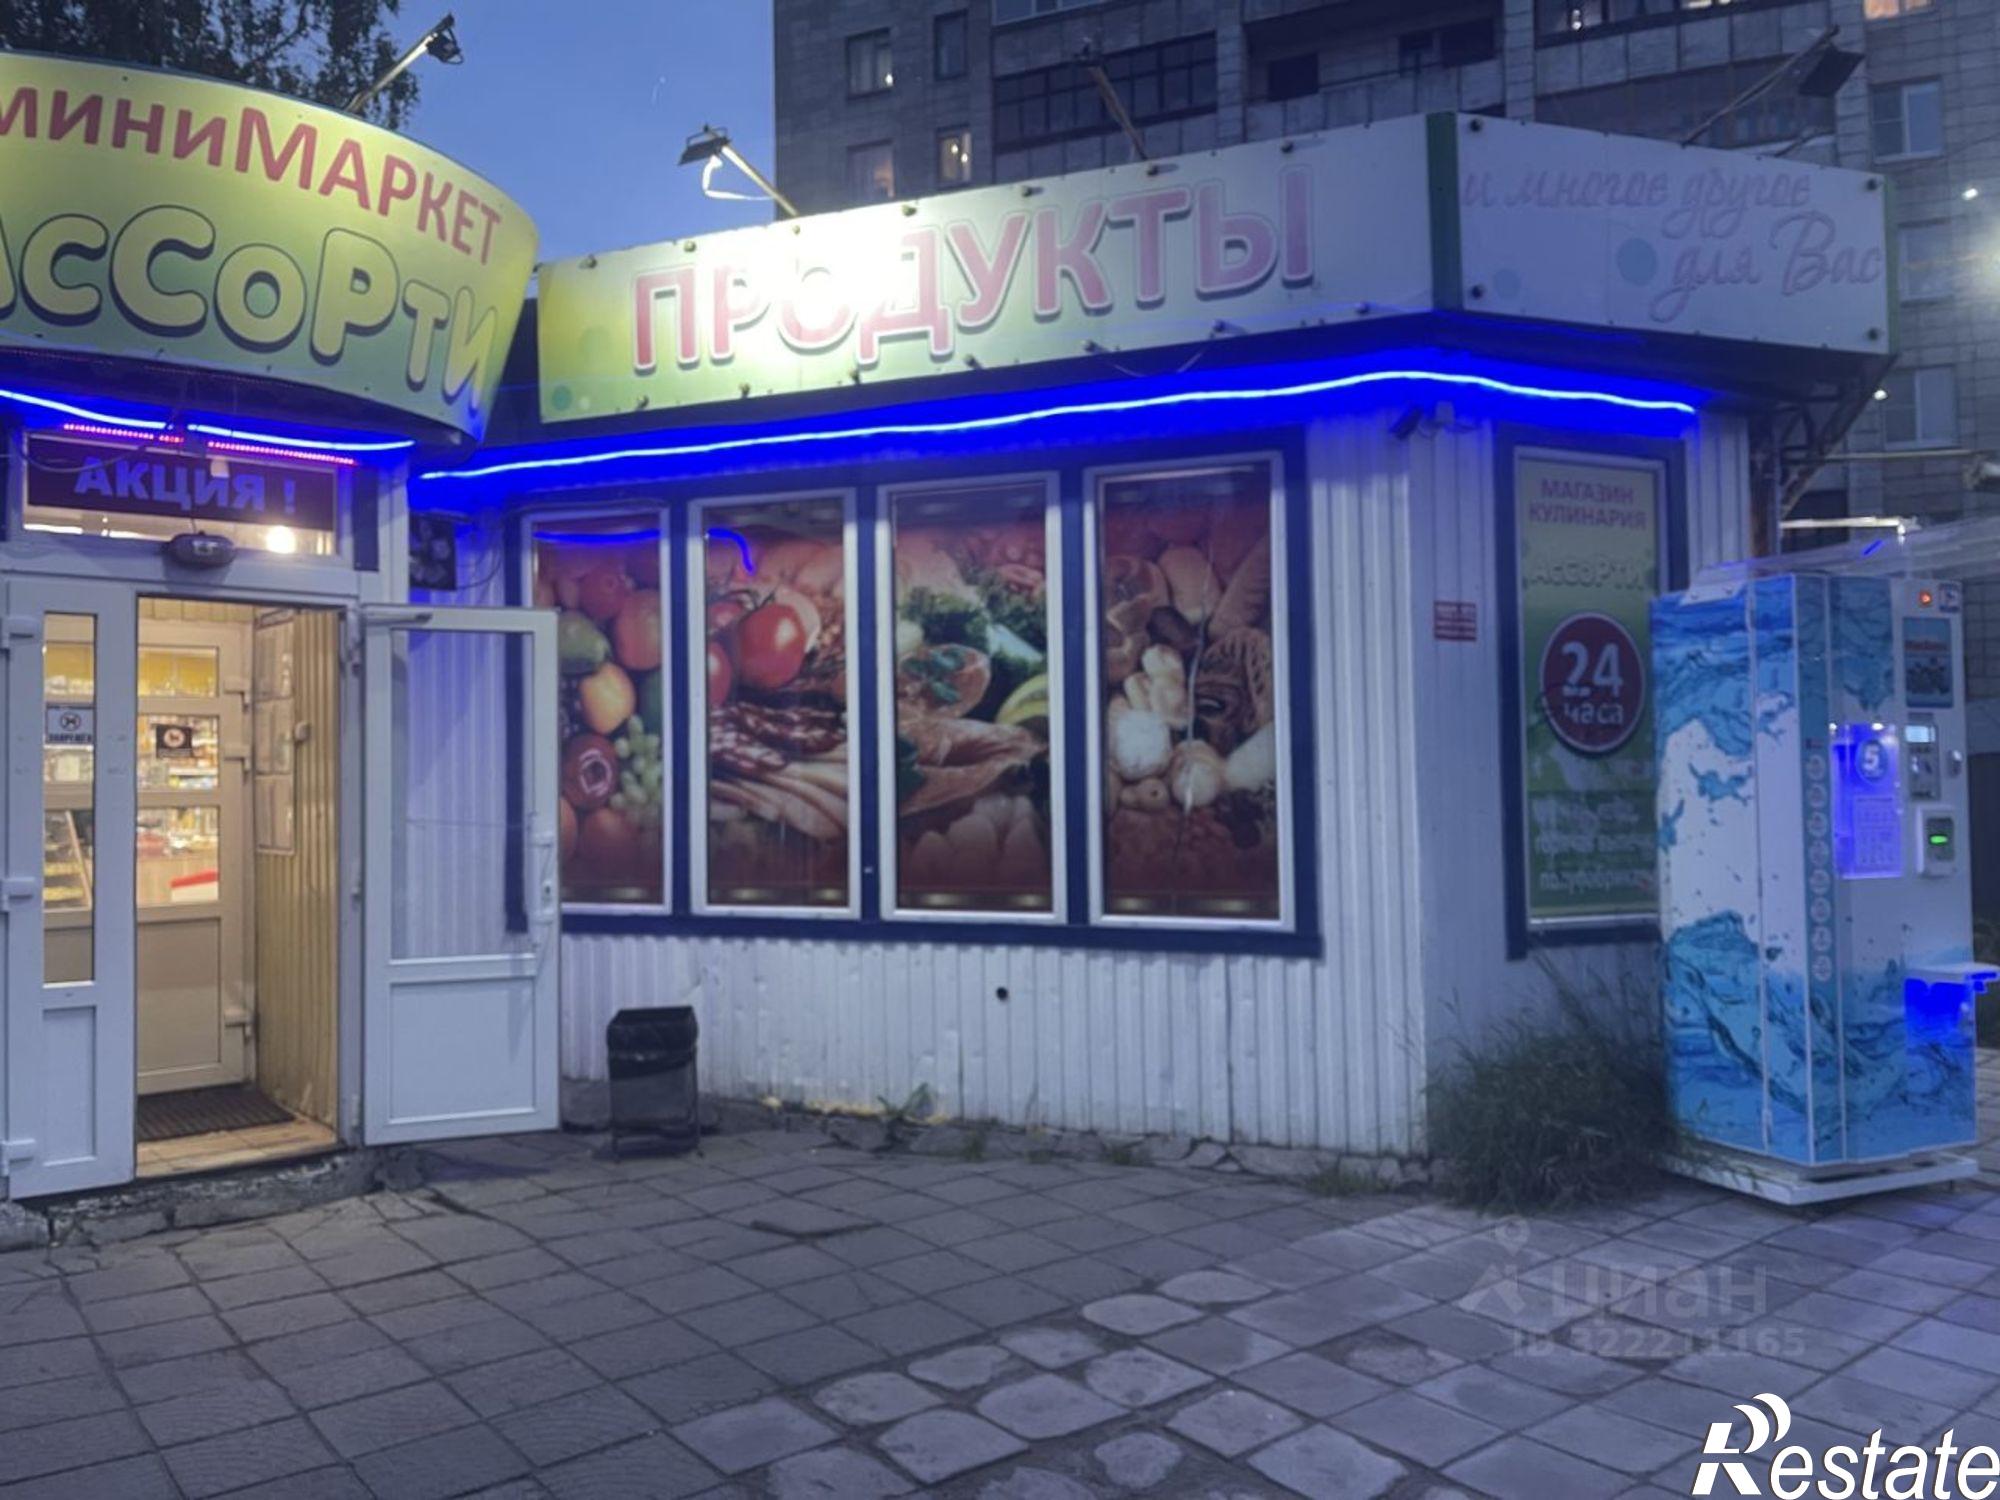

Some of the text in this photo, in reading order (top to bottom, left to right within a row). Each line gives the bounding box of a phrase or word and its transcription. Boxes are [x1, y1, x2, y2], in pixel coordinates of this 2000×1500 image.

[1461, 166, 1812, 240] и многое другое
[634, 164, 1316, 374] ПРОДУКТЫ
[1649, 209, 1882, 324] для Вас
[1529, 502, 1647, 530] КУЛИНАРИЯ
[1541, 479, 1634, 504] МАГАЗИН
[1561, 641, 1623, 697] 24
[1563, 701, 1624, 727] часа
